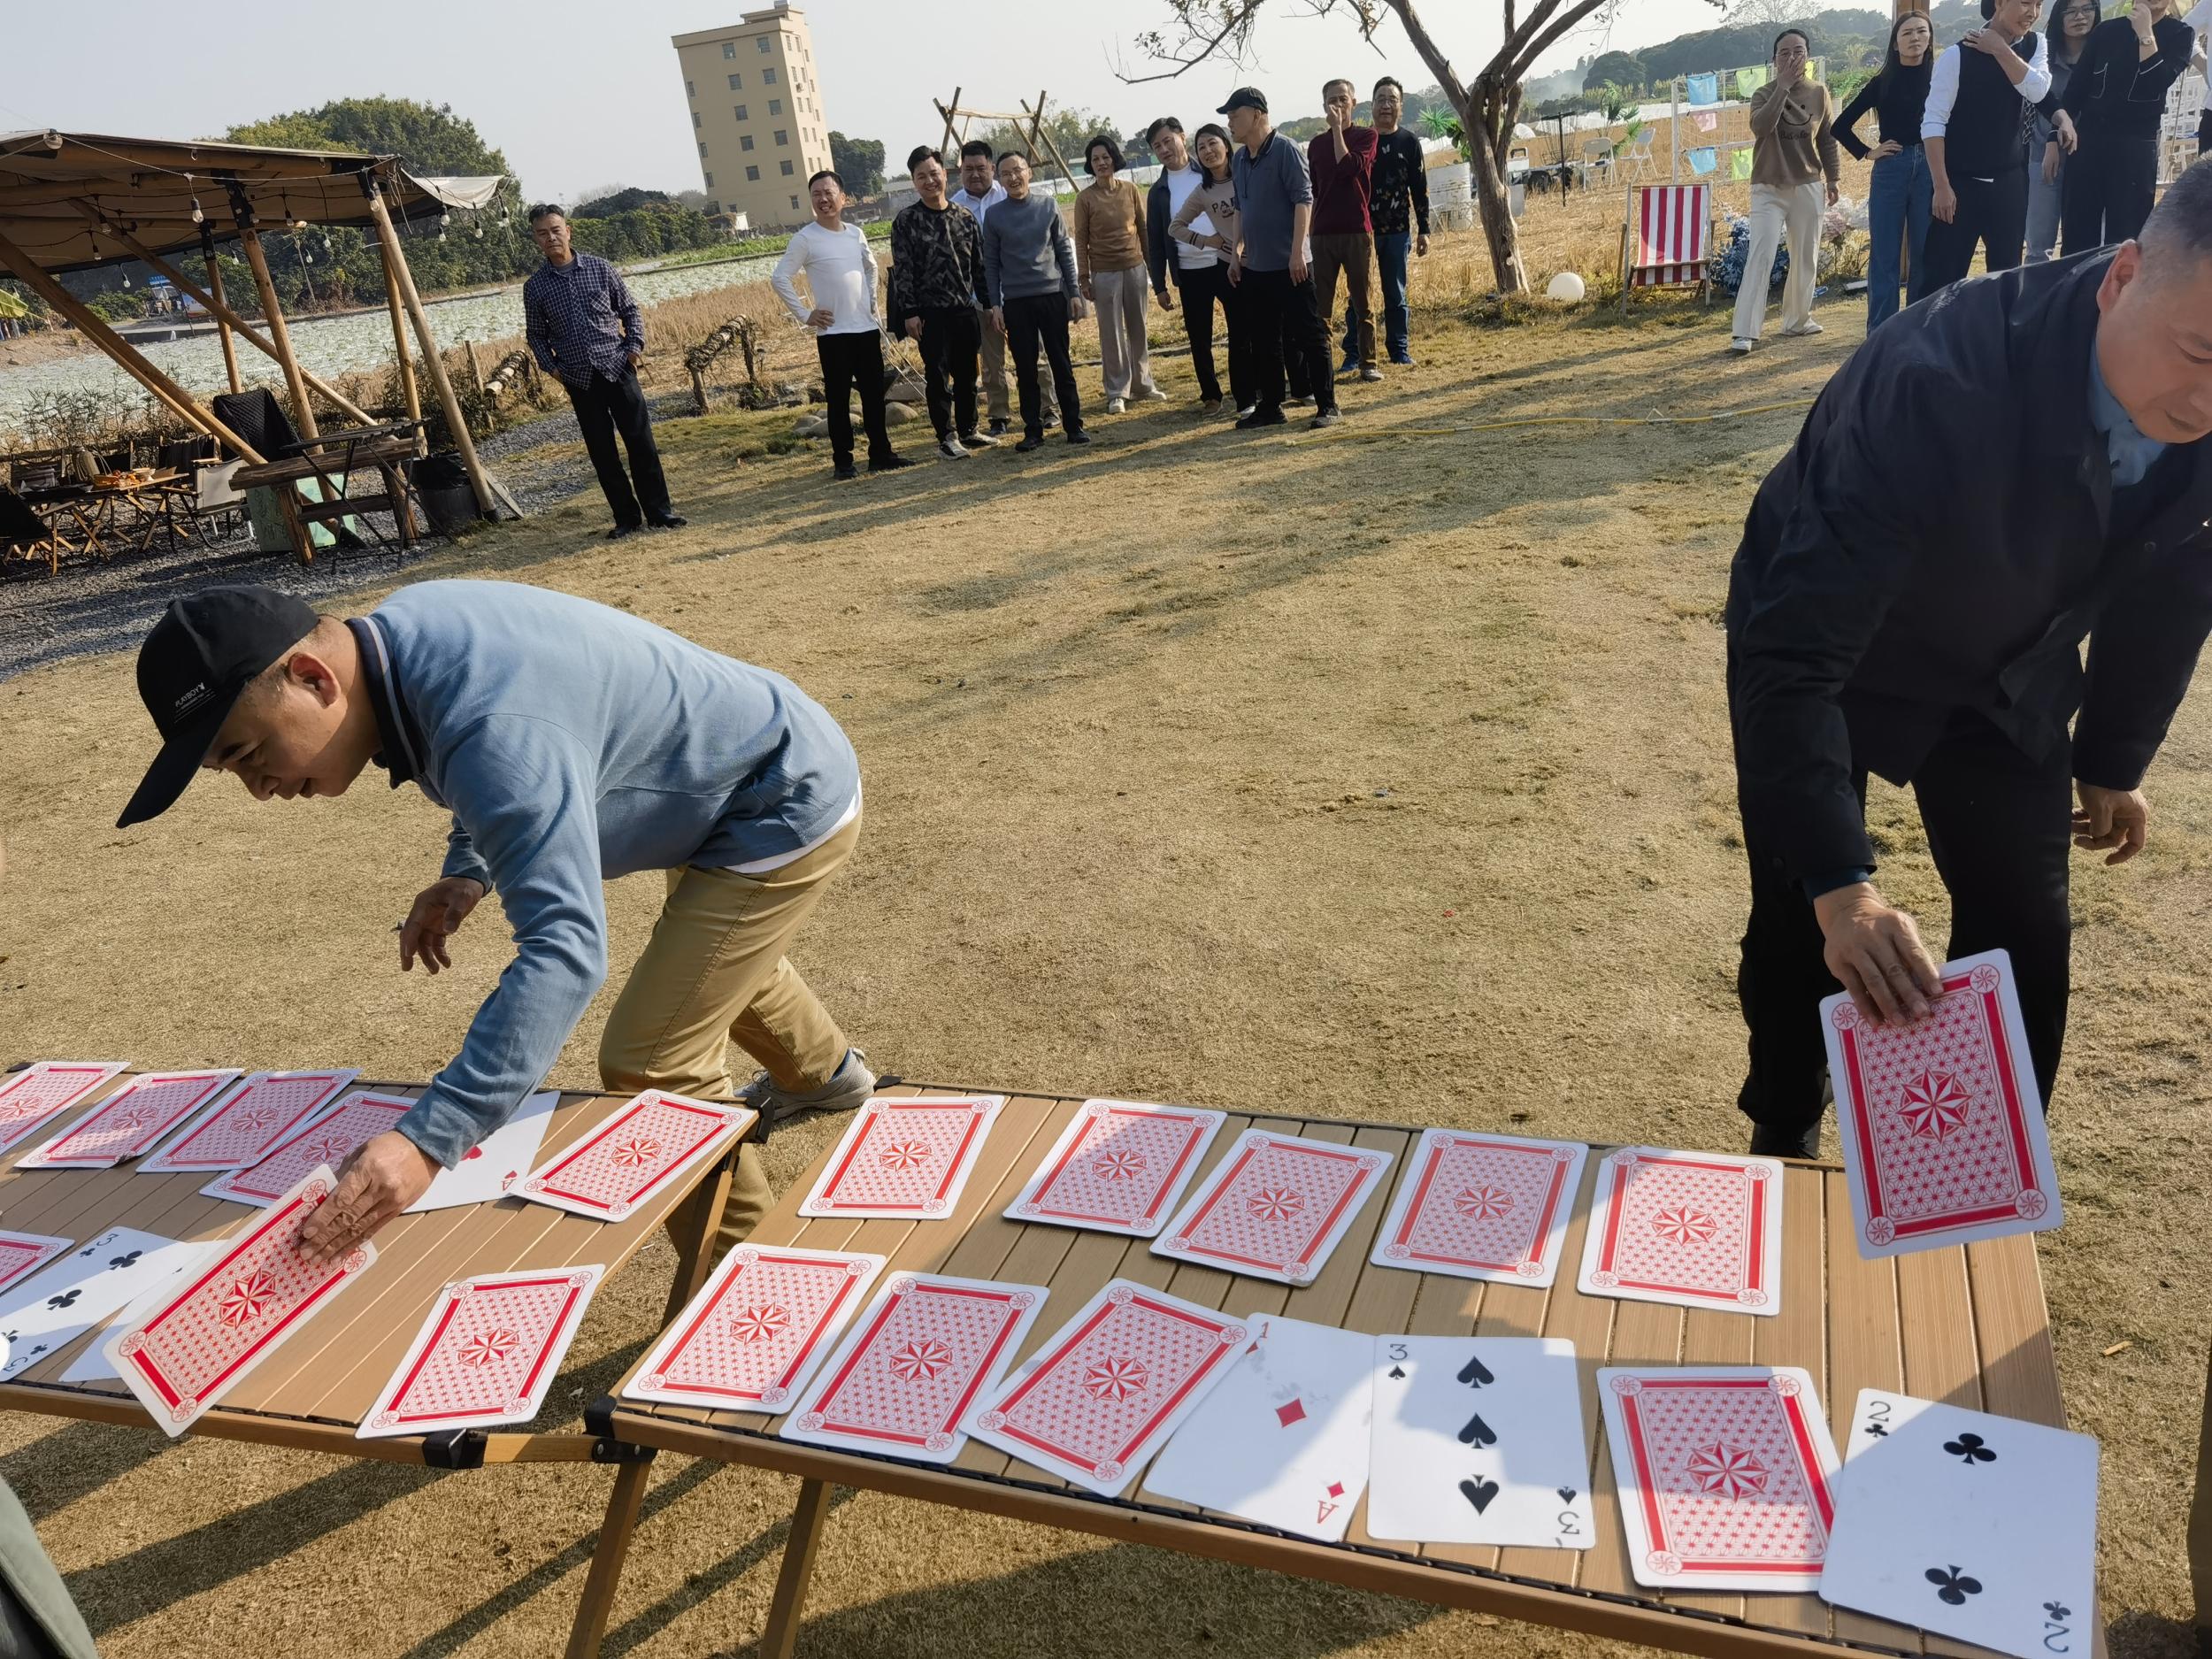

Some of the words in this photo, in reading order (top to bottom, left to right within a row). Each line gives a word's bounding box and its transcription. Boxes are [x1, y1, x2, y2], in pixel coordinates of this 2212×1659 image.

[1211, 197, 1236, 212] PA
[501, 1179, 517, 1192] A
[96, 1233, 119, 1246] 3
[1388, 1343, 1408, 1361] 3
[2, 1356, 28, 1371] 3
[1867, 1401, 1891, 1422] 2
[1317, 1500, 1340, 1525] A
[1557, 1510, 1580, 1535] 3
[2043, 1621, 2070, 1653] 2
